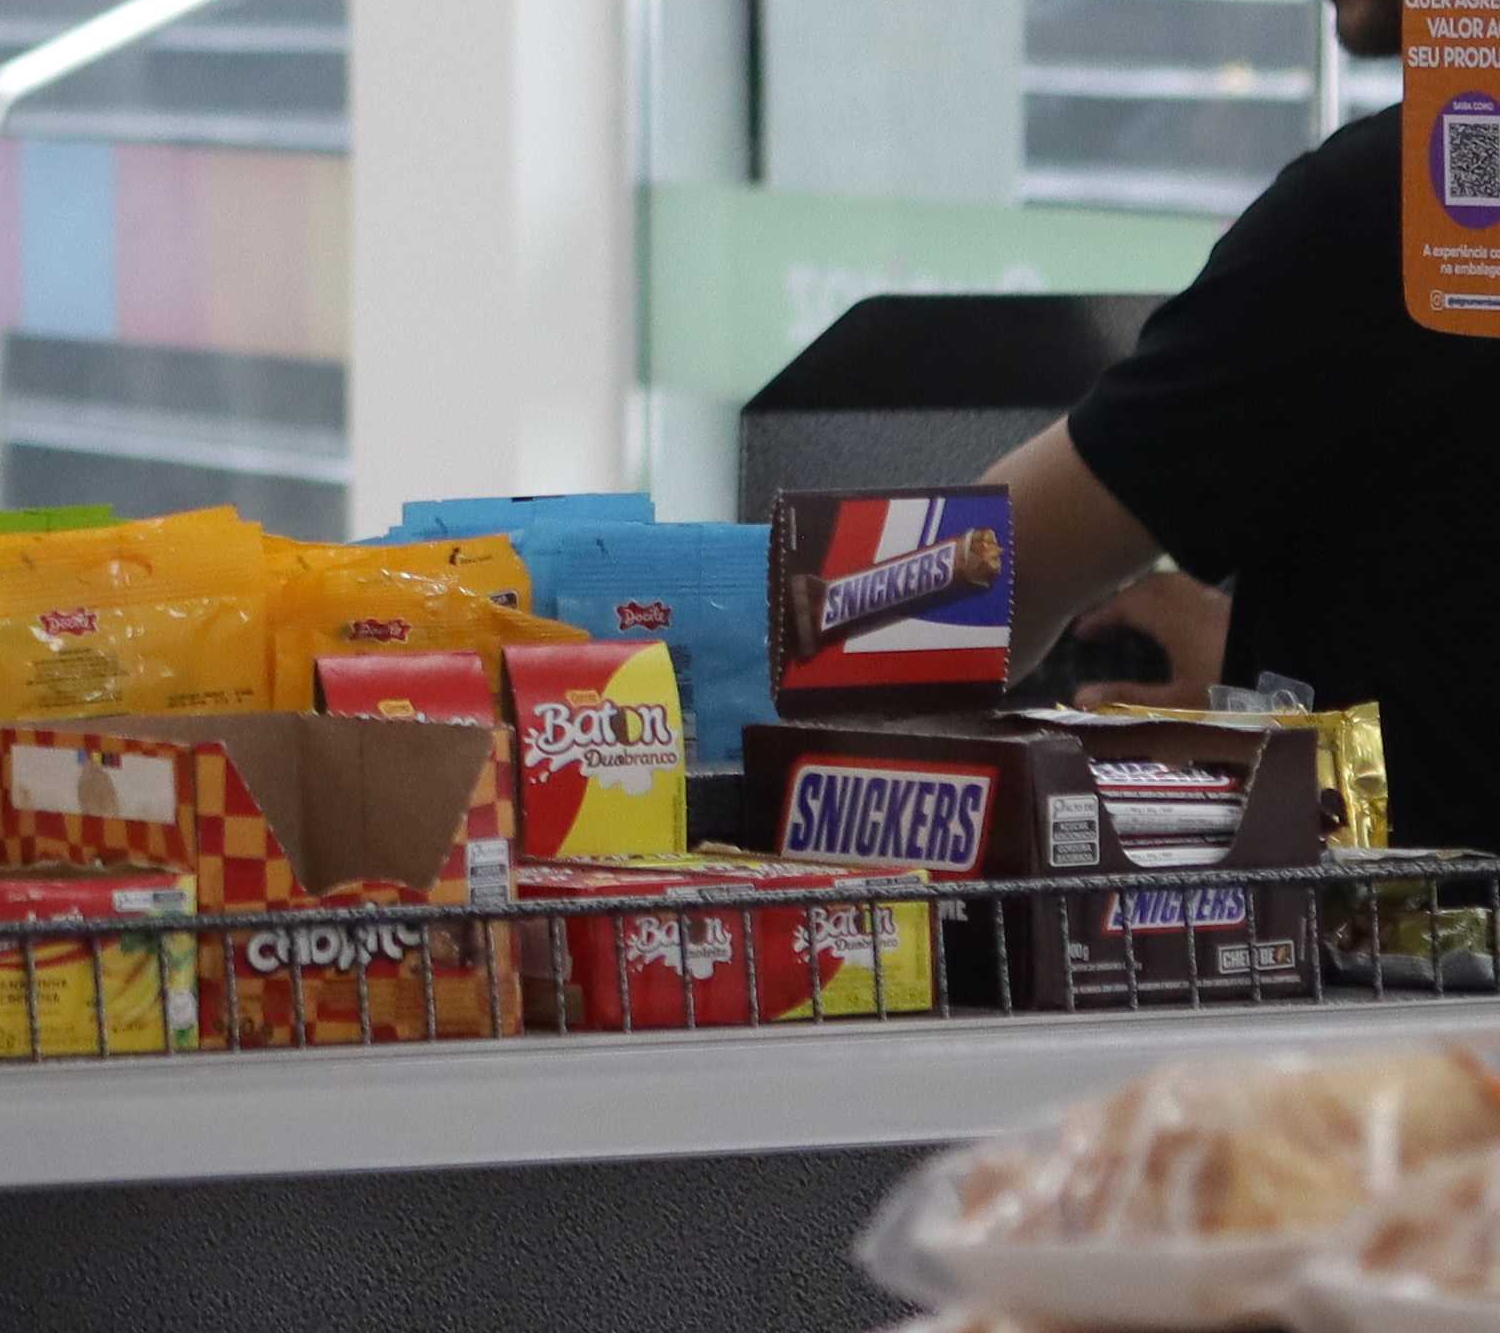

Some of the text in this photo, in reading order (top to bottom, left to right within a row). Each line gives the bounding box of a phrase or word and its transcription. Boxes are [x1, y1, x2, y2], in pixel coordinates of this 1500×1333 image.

[1426, 17, 1483, 39] VALOR
[1408, 45, 1440, 68] SEU
[824, 544, 953, 625] SNICKERS
[533, 700, 674, 755] Baton
[787, 772, 984, 866] SNICKERS
